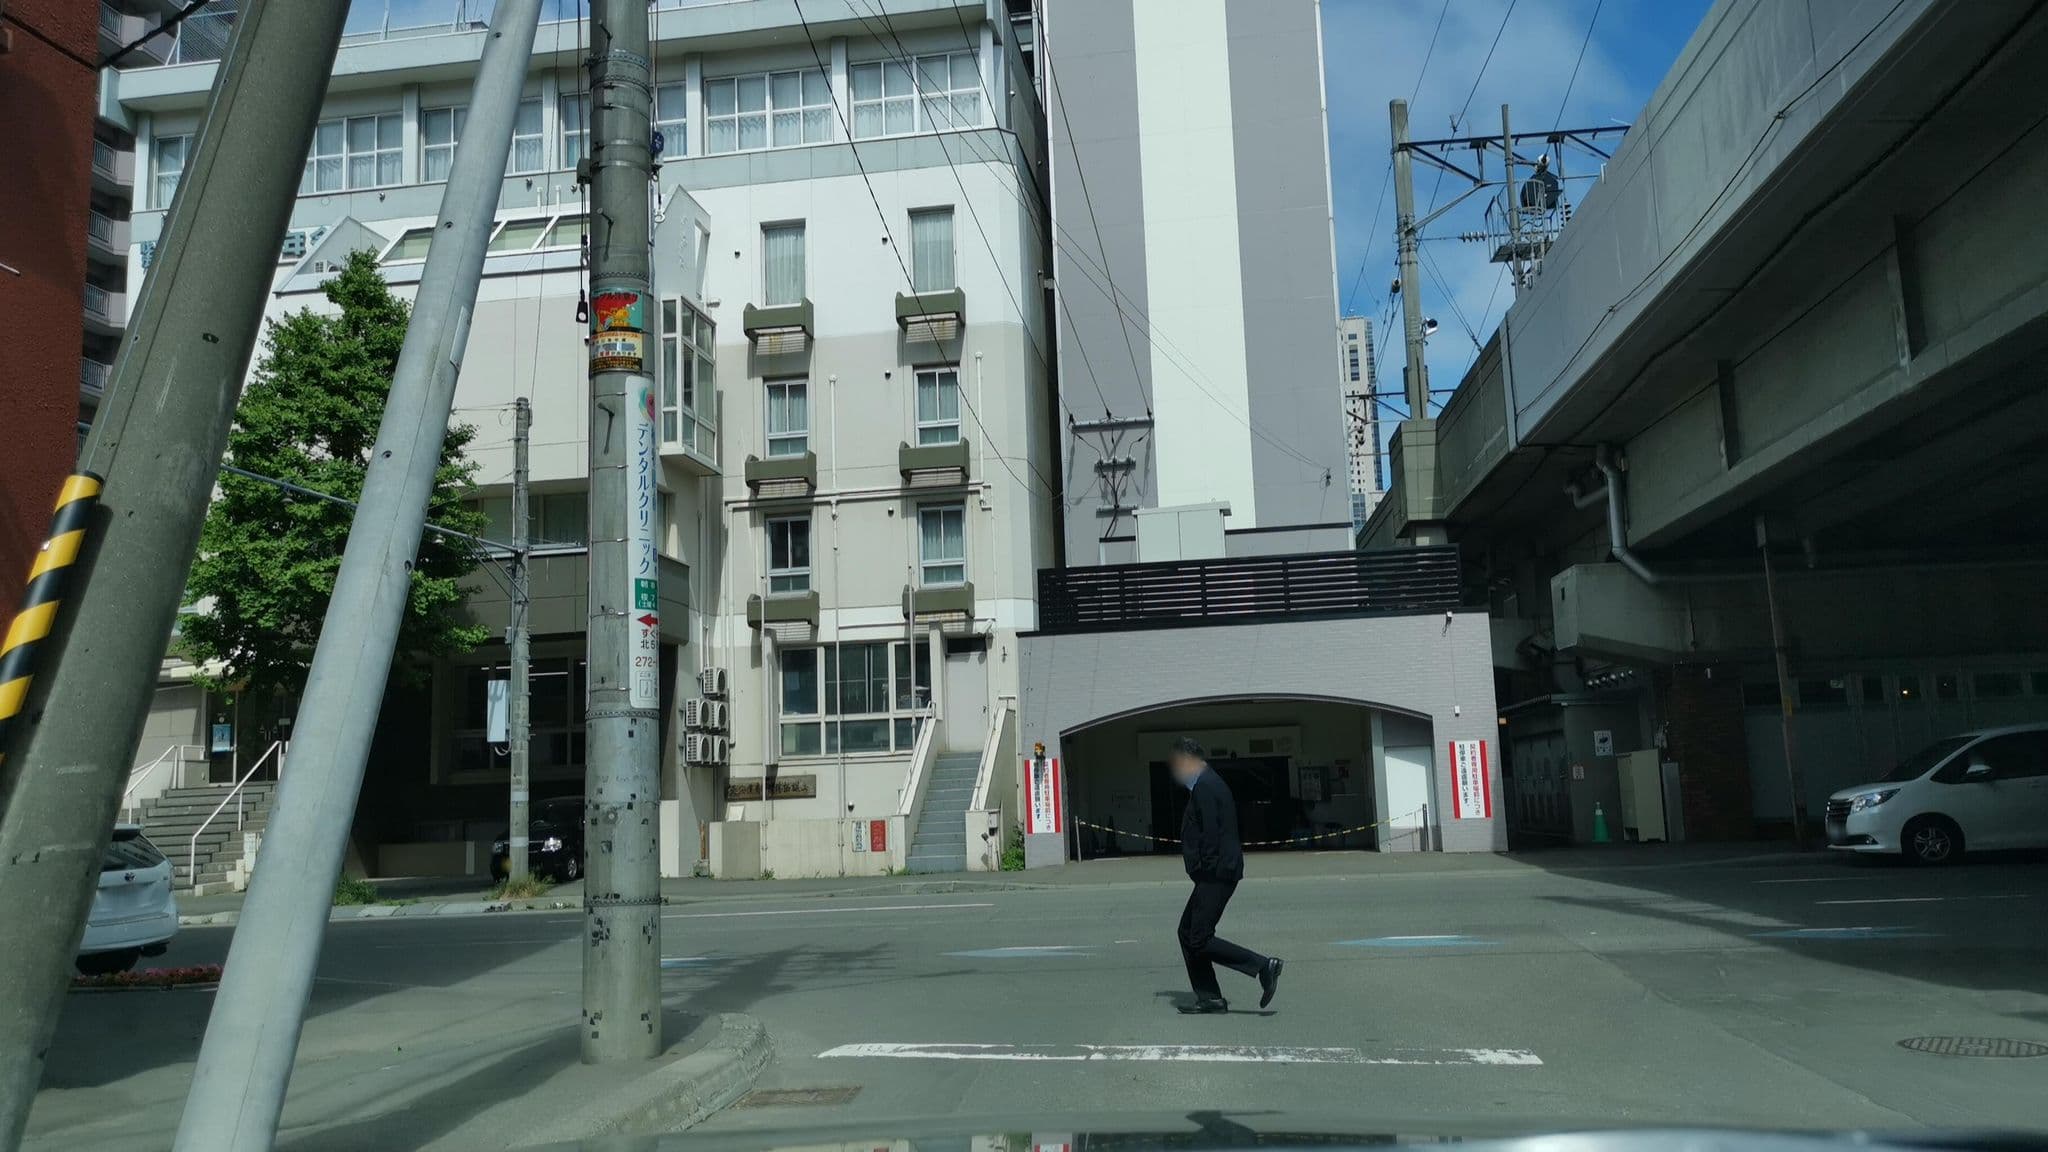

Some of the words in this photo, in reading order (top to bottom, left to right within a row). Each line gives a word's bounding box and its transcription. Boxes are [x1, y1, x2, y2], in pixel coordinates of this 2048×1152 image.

[637, 423, 650, 575] デンタルクリニック
[635, 656, 657, 667] 272-
